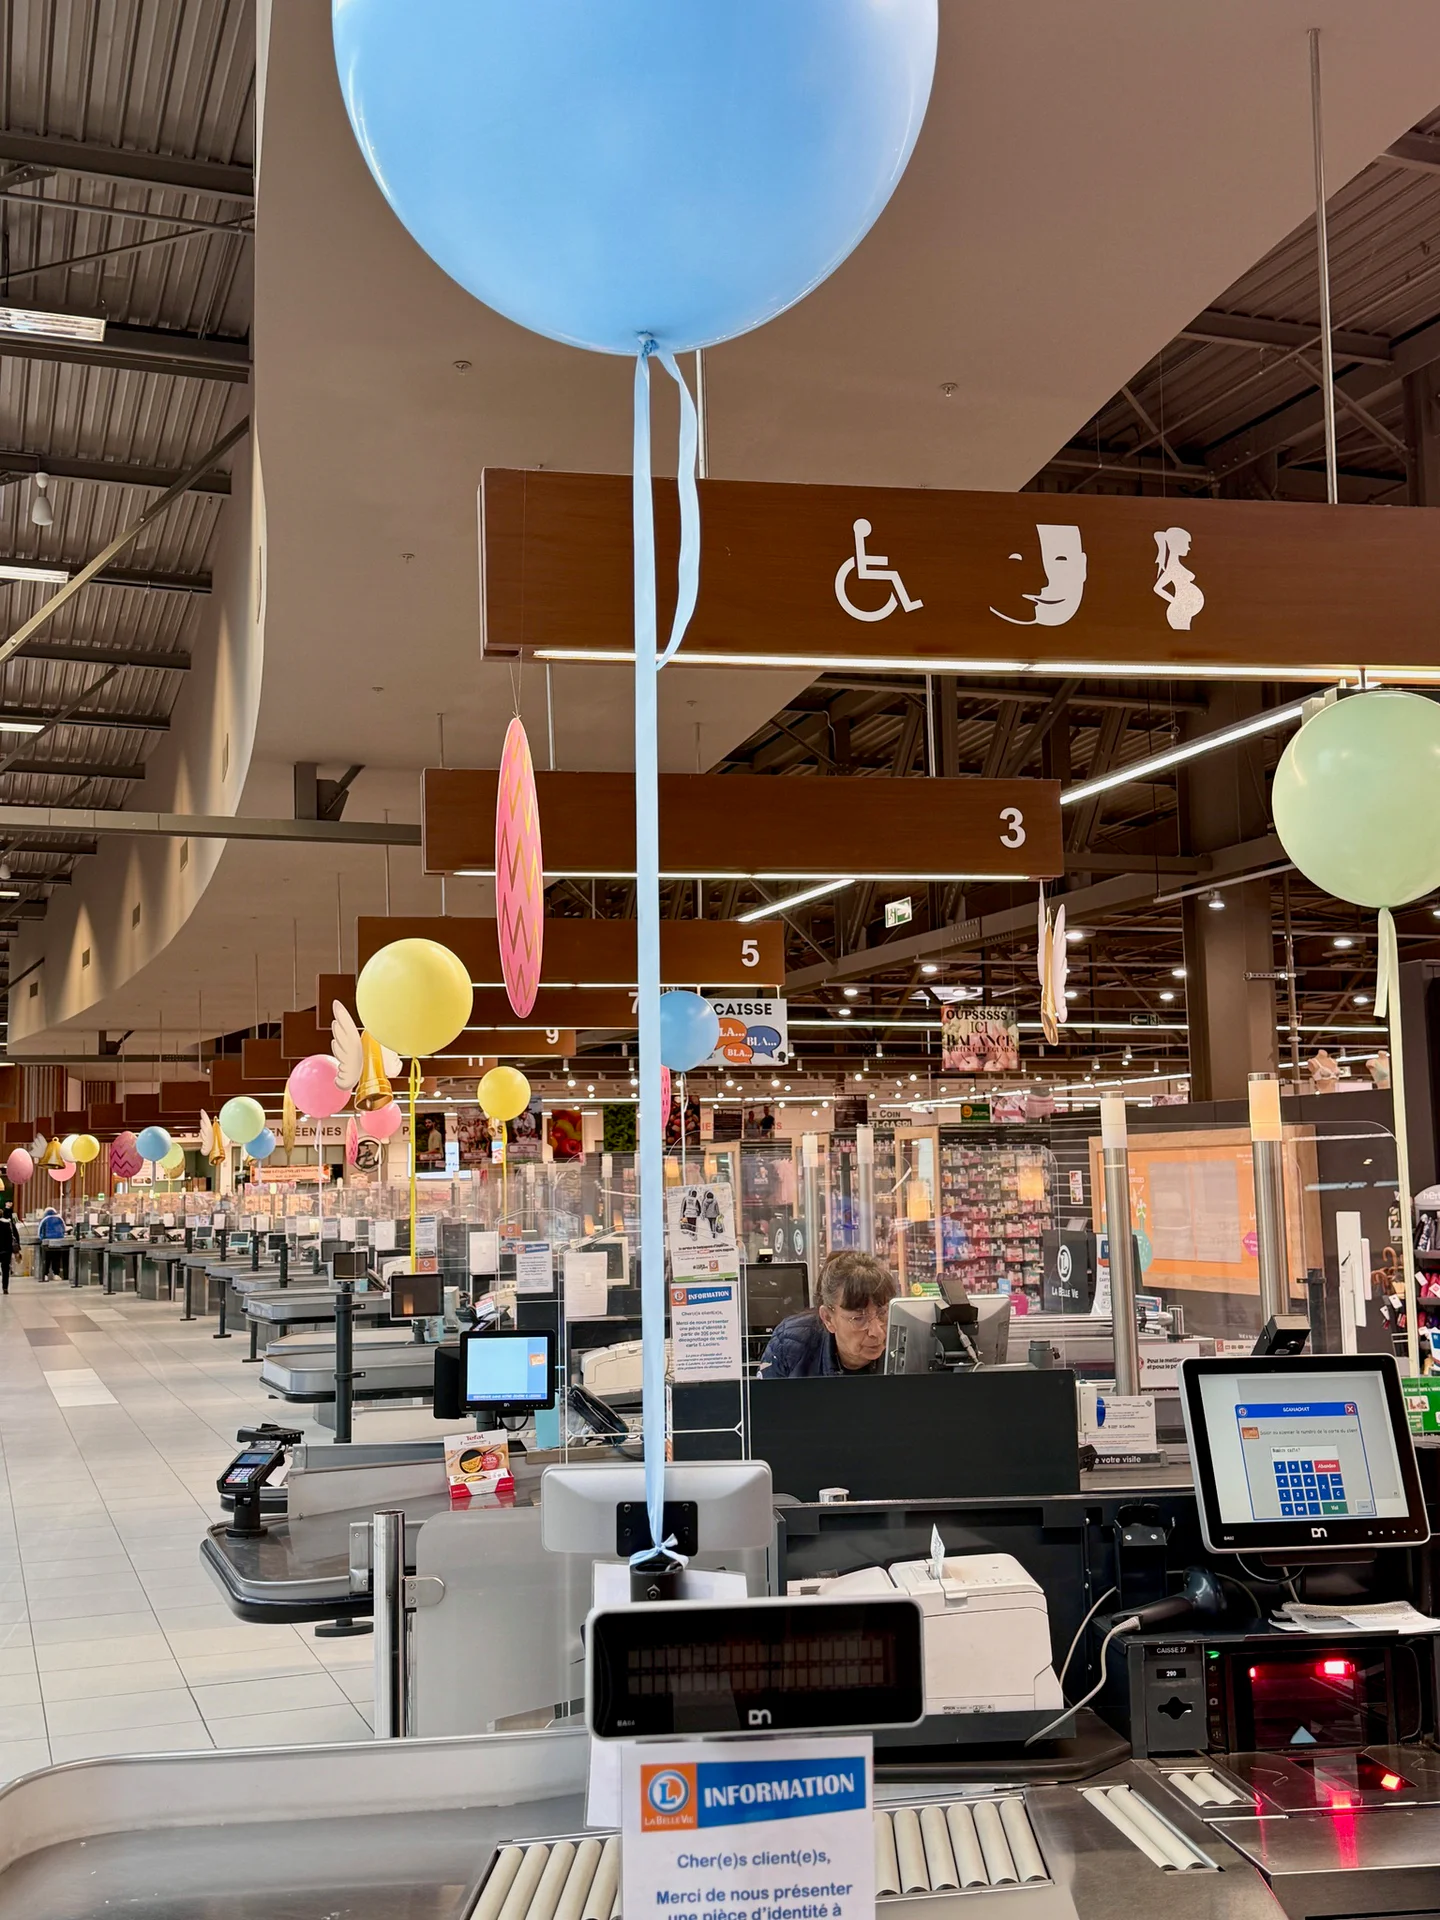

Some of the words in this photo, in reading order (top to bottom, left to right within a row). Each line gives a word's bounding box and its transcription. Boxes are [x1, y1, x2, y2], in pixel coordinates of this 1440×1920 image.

[999, 806, 1026, 848] 3
[740, 938, 760, 967] 5
[715, 1003, 772, 1016] CAISSE
[719, 1027, 745, 1037] LA...
[971, 1021, 989, 1033] ICI
[946, 1034, 1015, 1047] BALANCE
[687, 1290, 730, 1300] INFORMATION
[1101, 1456, 1120, 1464] votre
[1122, 1455, 1142, 1463] visite
[1156, 1646, 1179, 1654] CAISSE
[704, 1772, 855, 1809] INFORMATION
[644, 1816, 656, 1826] LA
[656, 1815, 680, 1825] BELLE
[680, 1814, 694, 1824] VIE
[677, 1852, 748, 1870] Cher(e)s
[752, 1849, 832, 1867] client(e)s,
[656, 1888, 701, 1905] Merci
[705, 1888, 726, 1903] de
[730, 1890, 769, 1902] nous
[773, 1882, 853, 1902] présenter
[668, 1911, 697, 1920] une
[702, 1906, 748, 1920] pièce
[832, 1902, 842, 1917] à
